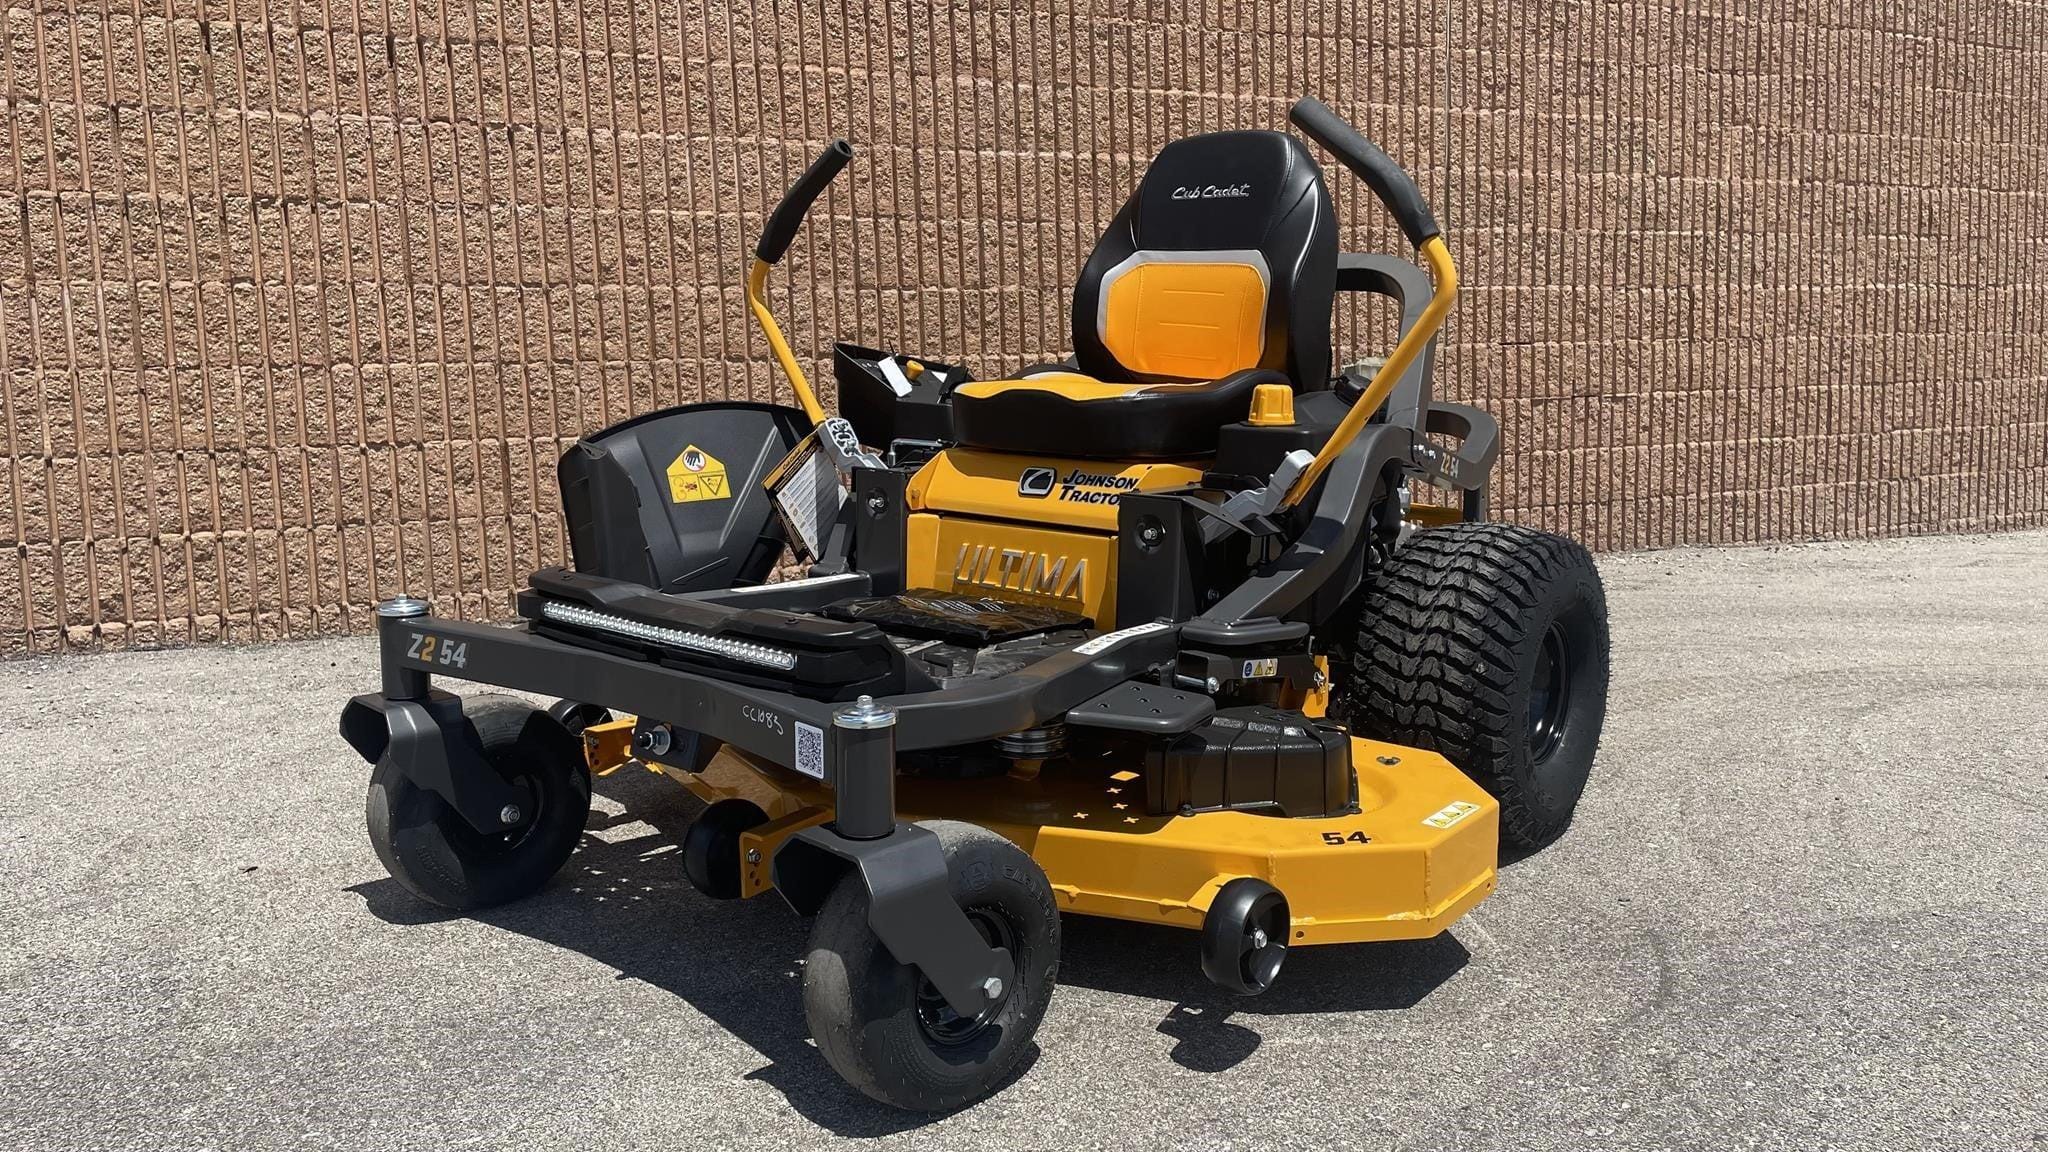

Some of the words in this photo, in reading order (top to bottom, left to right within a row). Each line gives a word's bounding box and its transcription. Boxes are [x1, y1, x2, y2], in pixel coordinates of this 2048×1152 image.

[1171, 186, 1201, 199] Cub
[1202, 184, 1251, 198] Cadet
[1063, 469, 1139, 490] JOHNSON
[1059, 486, 1120, 506] TRACTO
[954, 542, 1088, 603] ULTIMA
[407, 632, 436, 662] Z2
[440, 639, 467, 669] 54
[1321, 830, 1373, 846] 54
